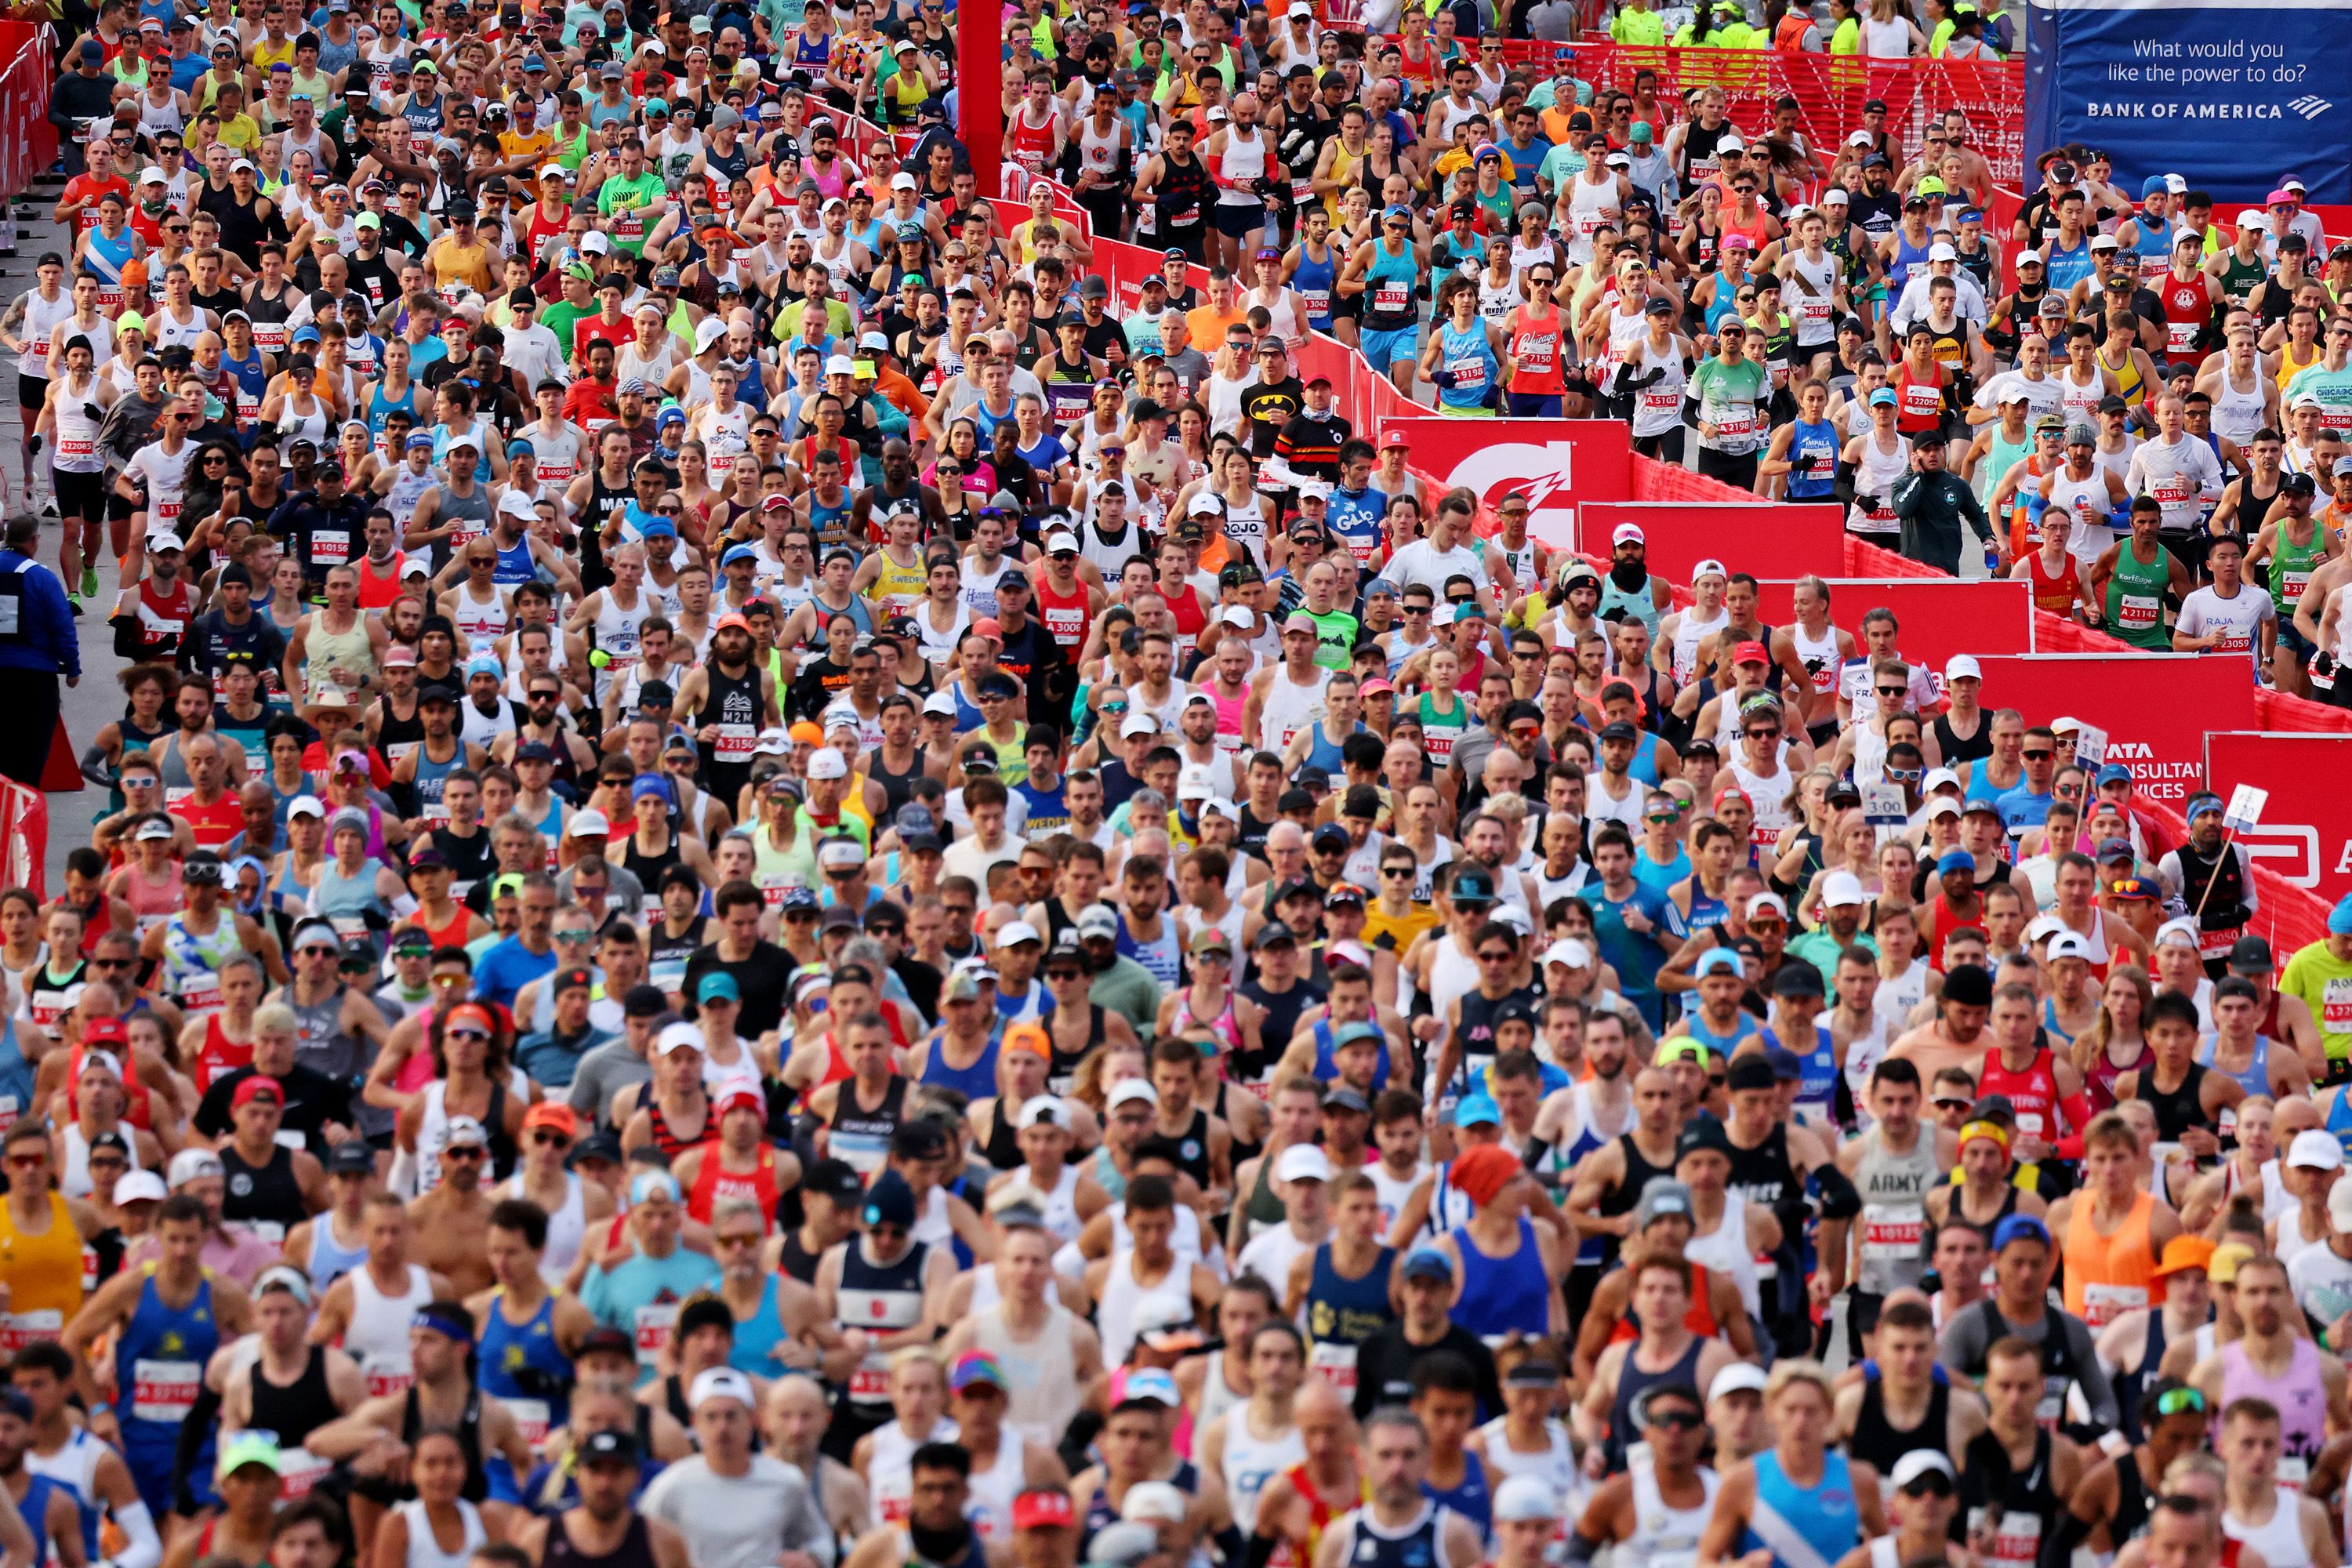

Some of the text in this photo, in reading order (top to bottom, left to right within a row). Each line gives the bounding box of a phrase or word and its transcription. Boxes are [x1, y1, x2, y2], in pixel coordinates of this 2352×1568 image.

[2133, 39, 2284, 62] What would you
[2108, 64, 2307, 86] like the power to do?
[2088, 103, 2282, 119] BANK OF AMERICA
[1461, 368, 1483, 378] 9198
[1655, 396, 1677, 405] 5102
[1065, 408, 1086, 417] 7117
[1729, 422, 1749, 430] 2198
[452, 534, 459, 543] A
[321, 543, 349, 552] 10156
[2119, 573, 2152, 584] KorfEdge
[891, 607, 898, 615] A
[2130, 608, 2157, 618] 21142
[1057, 623, 1081, 632] 3006
[146, 632, 153, 641] A
[717, 739, 754, 749] A 2150
[1869, 801, 1901, 814] 3:00
[2210, 931, 2238, 942] 5050
[2325, 1006, 2334, 1016] A
[1869, 1174, 1922, 1192] ARMY
[1867, 1227, 1876, 1238] A
